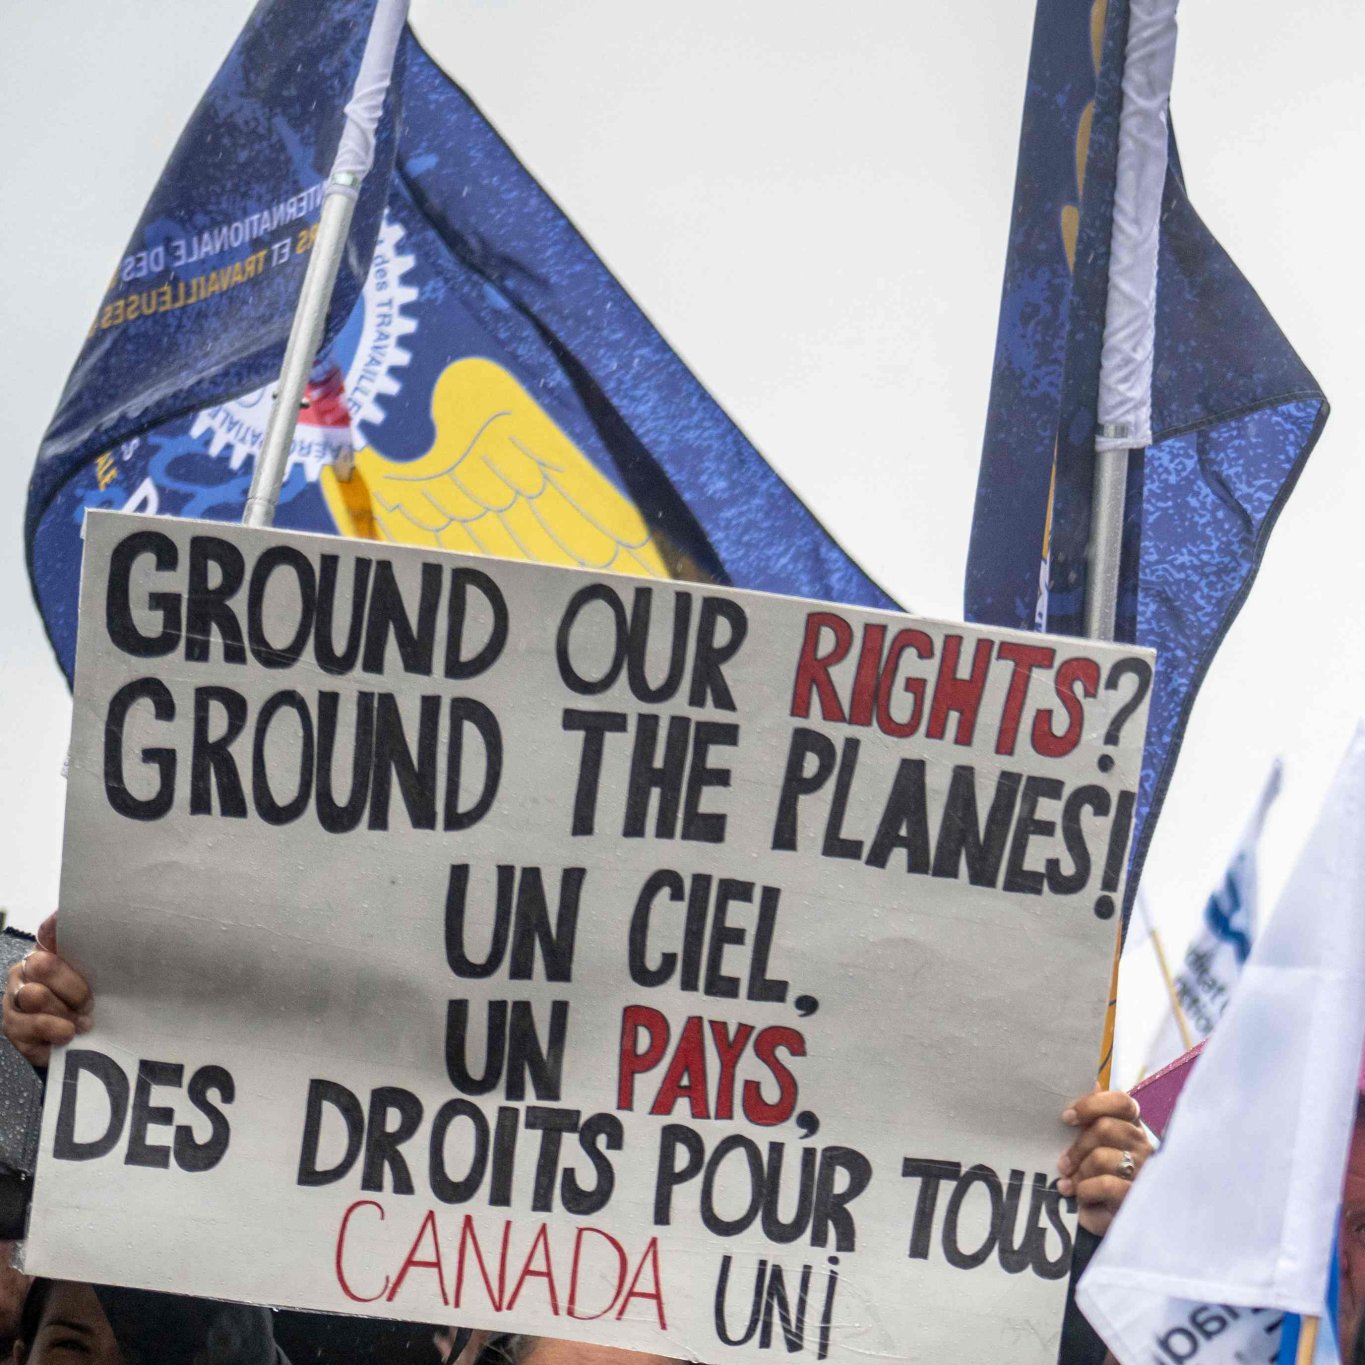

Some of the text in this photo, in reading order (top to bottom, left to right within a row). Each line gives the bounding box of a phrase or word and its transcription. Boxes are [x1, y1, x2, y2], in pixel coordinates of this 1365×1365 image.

[106, 531, 1154, 773] GROUND OUR RIGHTS?
[104, 677, 502, 834] GROUND
[562, 709, 739, 843] THE
[771, 727, 1137, 920] PLANES!
[444, 864, 587, 983] UN
[444, 999, 569, 1101] UN
[52, 1049, 1078, 1281] DES DROITS POUR TOUS
[335, 1200, 668, 1331] CANADA
